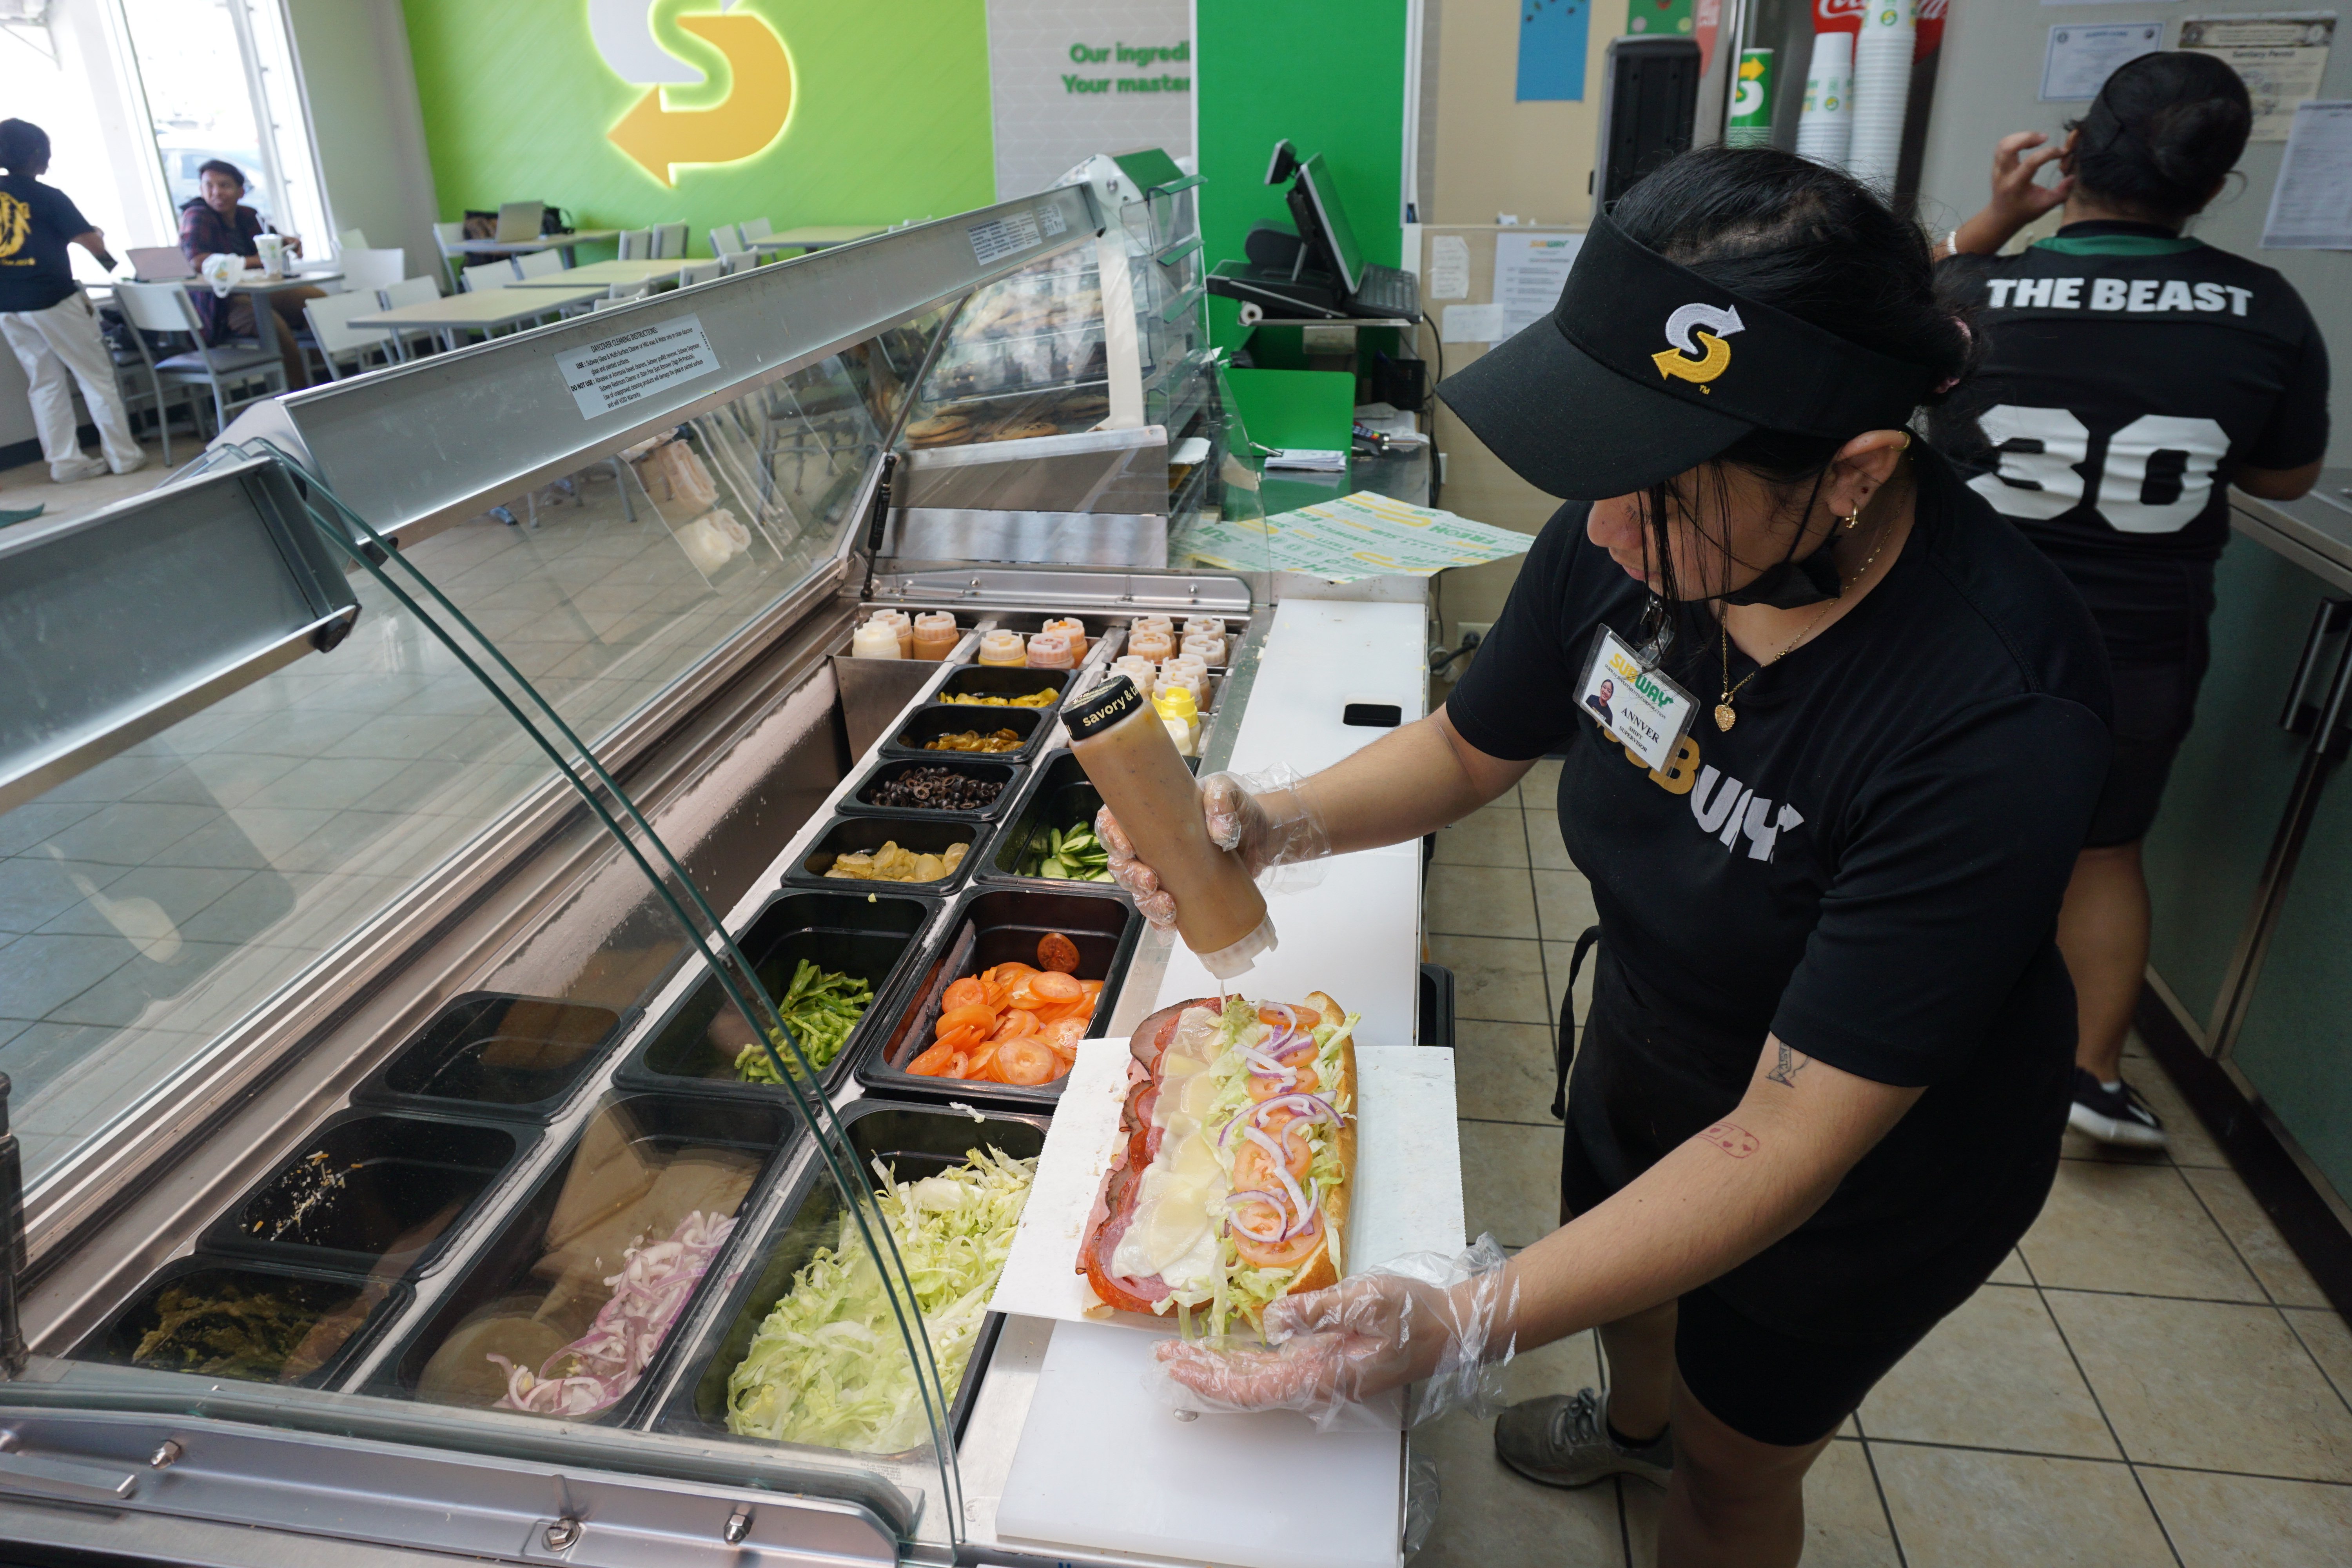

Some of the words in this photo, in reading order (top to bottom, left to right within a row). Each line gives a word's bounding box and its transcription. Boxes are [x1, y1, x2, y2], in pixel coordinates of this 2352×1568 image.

[1070, 42, 1110, 63] Our
[1062, 74, 1110, 93] Your
[1986, 278, 2085, 309] THE
[2090, 279, 2253, 317] BEAST
[590, 340, 613, 353] DAYCOVER
[612, 335, 631, 346] CLEANING
[609, 348, 629, 358] Multi-Surface
[595, 375, 609, 383] Abrasive
[612, 368, 626, 377] Ammonia
[605, 361, 617, 371] painted
[611, 379, 626, 387] Restroom
[613, 385, 631, 396] unapproved
[642, 377, 654, 387] products
[1966, 405, 2231, 534] 30
[1609, 653, 1673, 708] SUBWAY
[1083, 697, 1125, 726] savory
[1124, 690, 1134, 701] &
[1640, 696, 1666, 719] CORPORATION
[1621, 708, 1659, 744] ANNVER
[1628, 726, 1643, 740] SHIFT
[1619, 726, 1648, 753] SUPERVISOR
